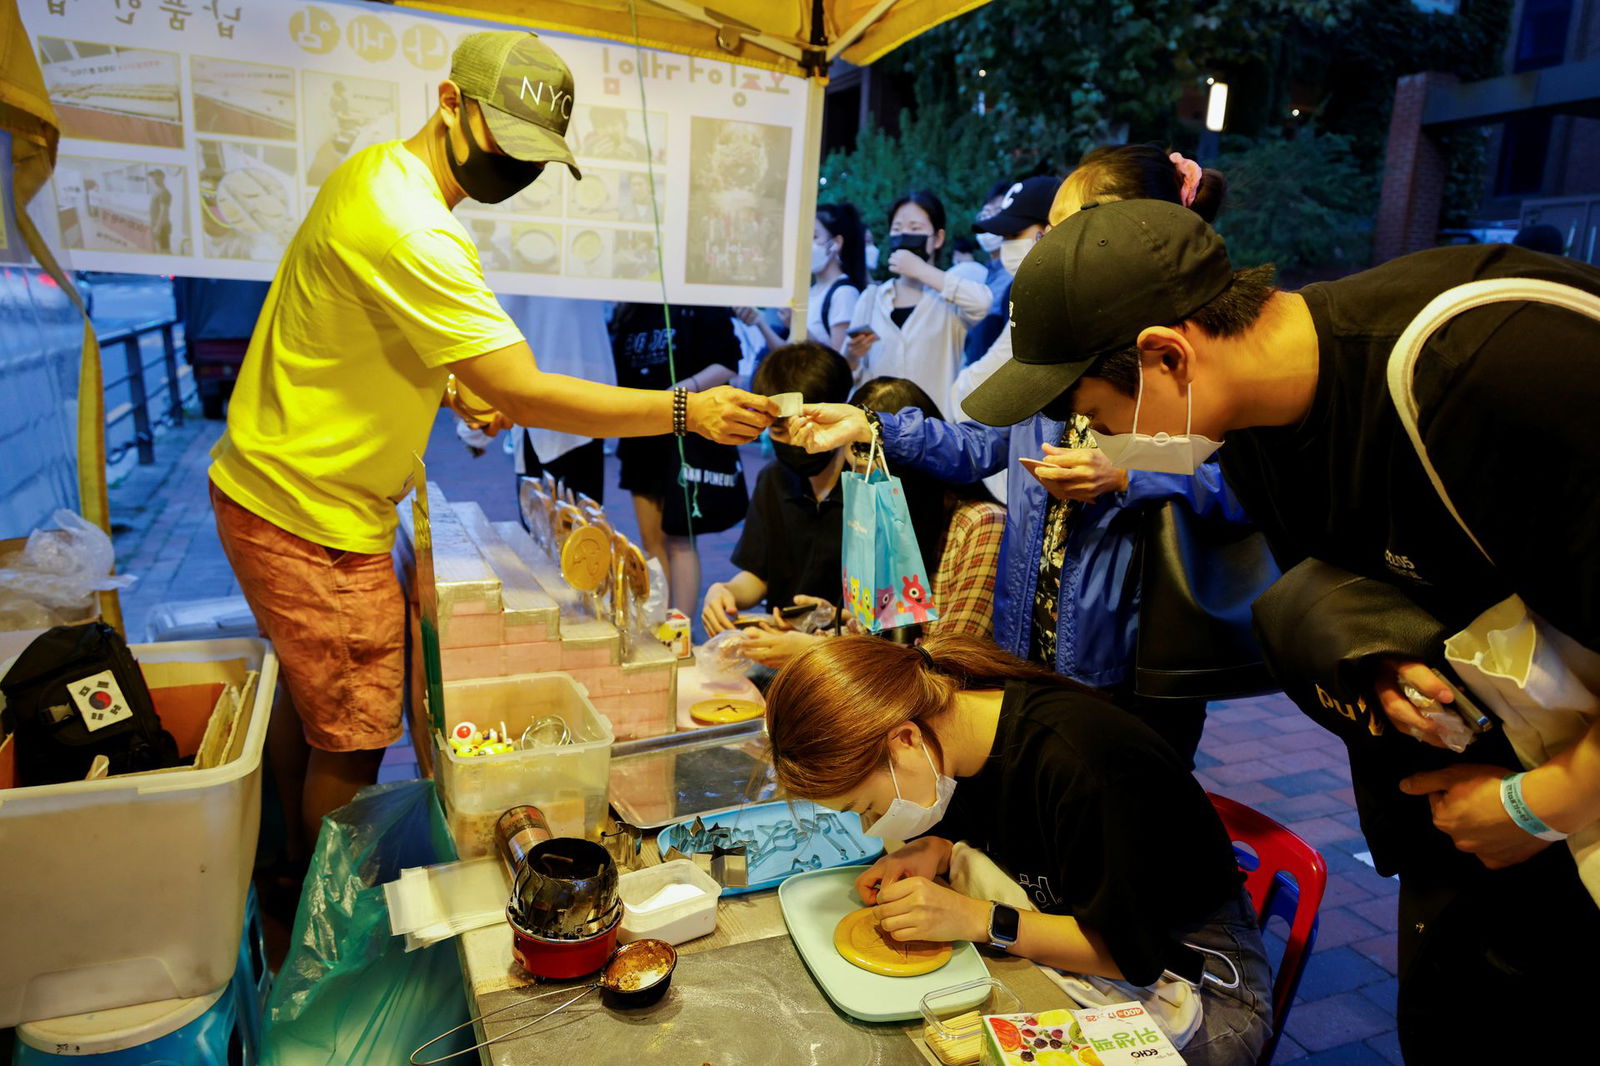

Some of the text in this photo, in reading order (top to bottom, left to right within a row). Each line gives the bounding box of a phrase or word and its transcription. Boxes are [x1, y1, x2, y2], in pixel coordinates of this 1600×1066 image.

[519, 75, 572, 120] NYC
[1090, 1028, 1161, 1052] 위생팩
[1130, 1048, 1159, 1060] ECHO
